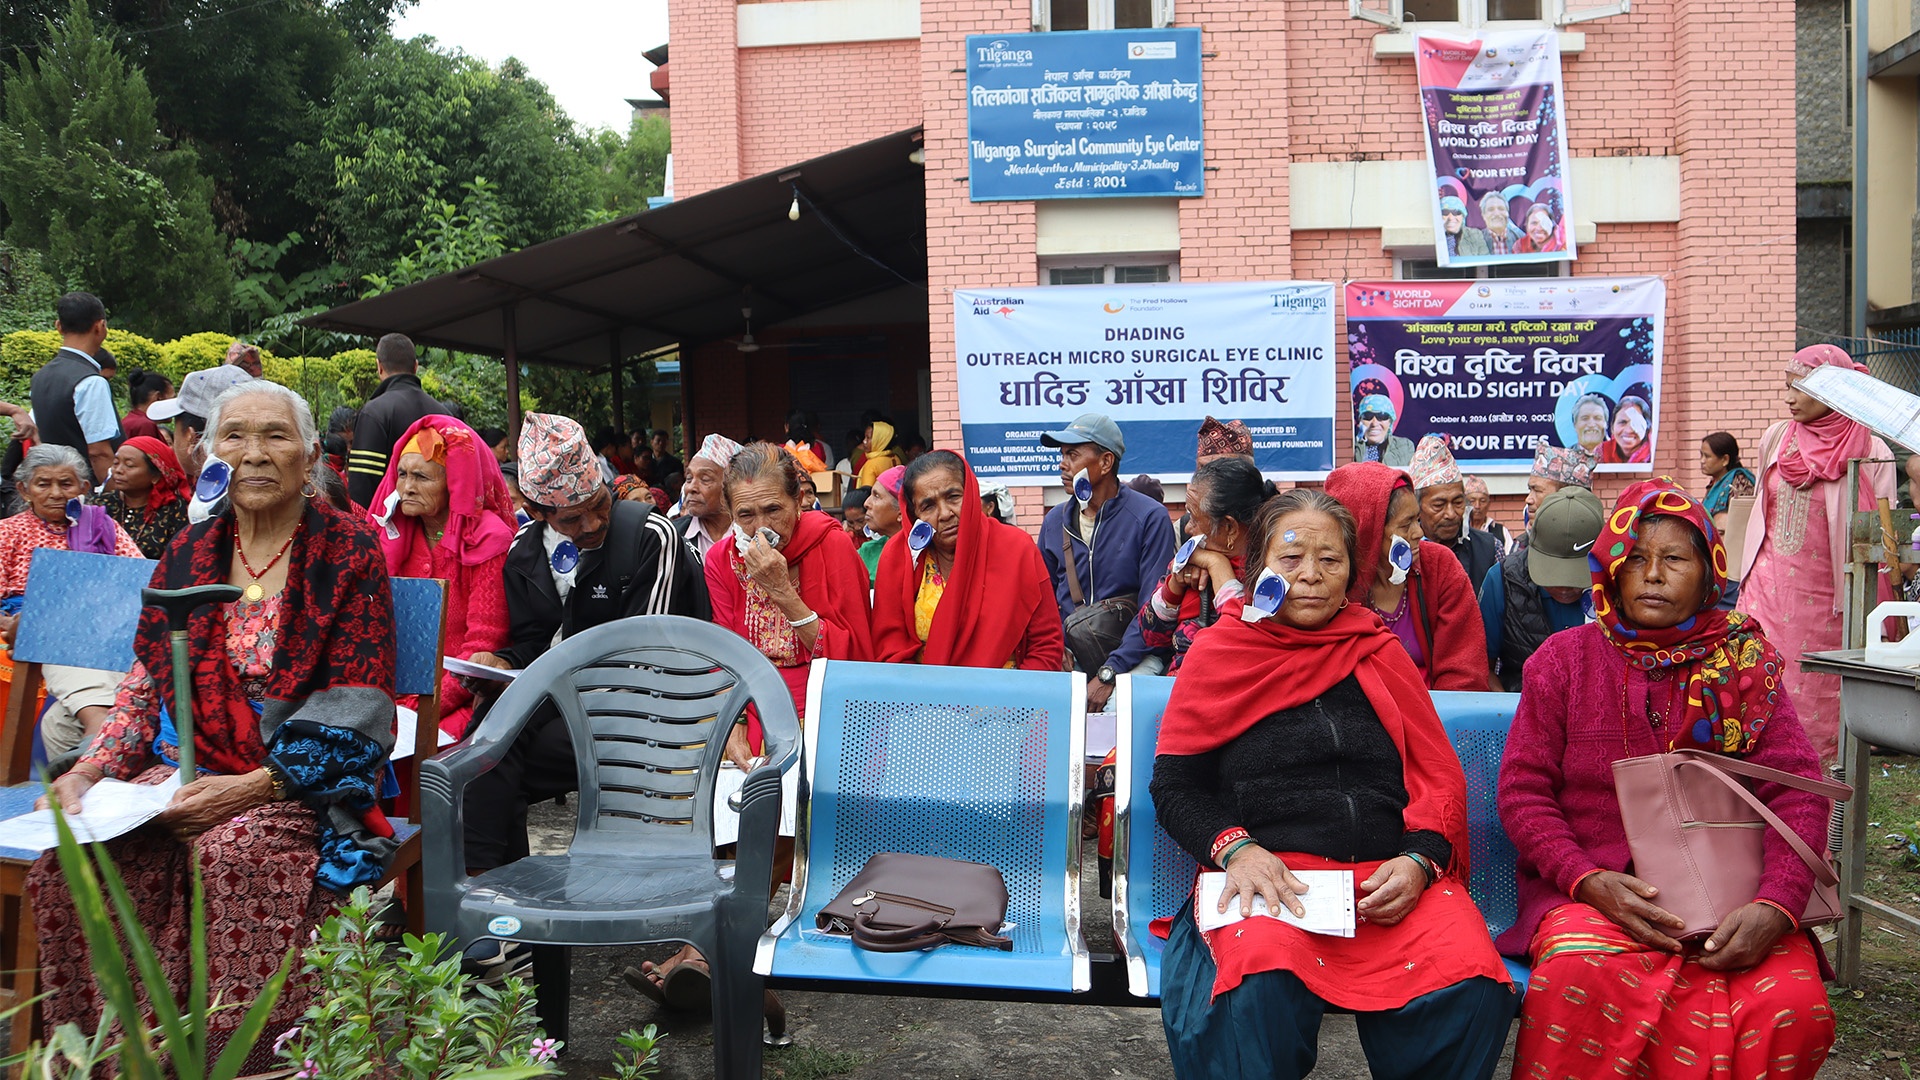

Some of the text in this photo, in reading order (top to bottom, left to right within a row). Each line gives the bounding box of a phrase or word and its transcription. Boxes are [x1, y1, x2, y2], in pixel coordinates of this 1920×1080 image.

[977, 47, 1033, 62] Tilganga
[1044, 69, 1069, 82] नेपाल
[971, 85, 1029, 107] तिलगंगा
[1083, 80, 1140, 106] सामुदायिक
[1172, 79, 1198, 103] केन्द्र
[1438, 119, 1466, 134] विश्व
[1502, 119, 1537, 133] दिवस
[1438, 133, 1539, 148] WORLD SIGHT DAY
[971, 134, 1201, 163] Tilganga Surgical Community Eye Center
[1004, 163, 1068, 176] Neelakantha
[1470, 166, 1527, 178] YOUR EYES
[1054, 177, 1083, 189] Estd
[1094, 176, 1127, 189] 2001
[1392, 290, 1432, 299] WORLD
[973, 297, 1024, 306] Australian
[1270, 294, 1327, 311] Tilganga
[1392, 299, 1444, 308] SIGHT DAY
[973, 307, 989, 315] Aid
[1105, 326, 1185, 341] DHADING
[1457, 323, 1483, 332] माया
[1421, 333, 1580, 346] Love your eyes, save your sight
[966, 347, 1324, 366] OUTREACH MICRO SURGICAL EYE CLINIC
[1394, 347, 1605, 380] विश्व दृष्टि दिवस
[999, 367, 1291, 407] धादिङ आँखा शिविर
[1408, 381, 1589, 399] WORLD SIGHT DAY
[1430, 415, 1460, 423] October
[1469, 415, 1487, 423] 2026
[1248, 426, 1284, 434] UPPORTED
[1282, 440, 1323, 448] FOUNDATION
[1451, 435, 1500, 450] YOUR
[1001, 455, 1055, 463] NEELAKANTHA-3,
[974, 465, 1006, 473] TILGANGA
